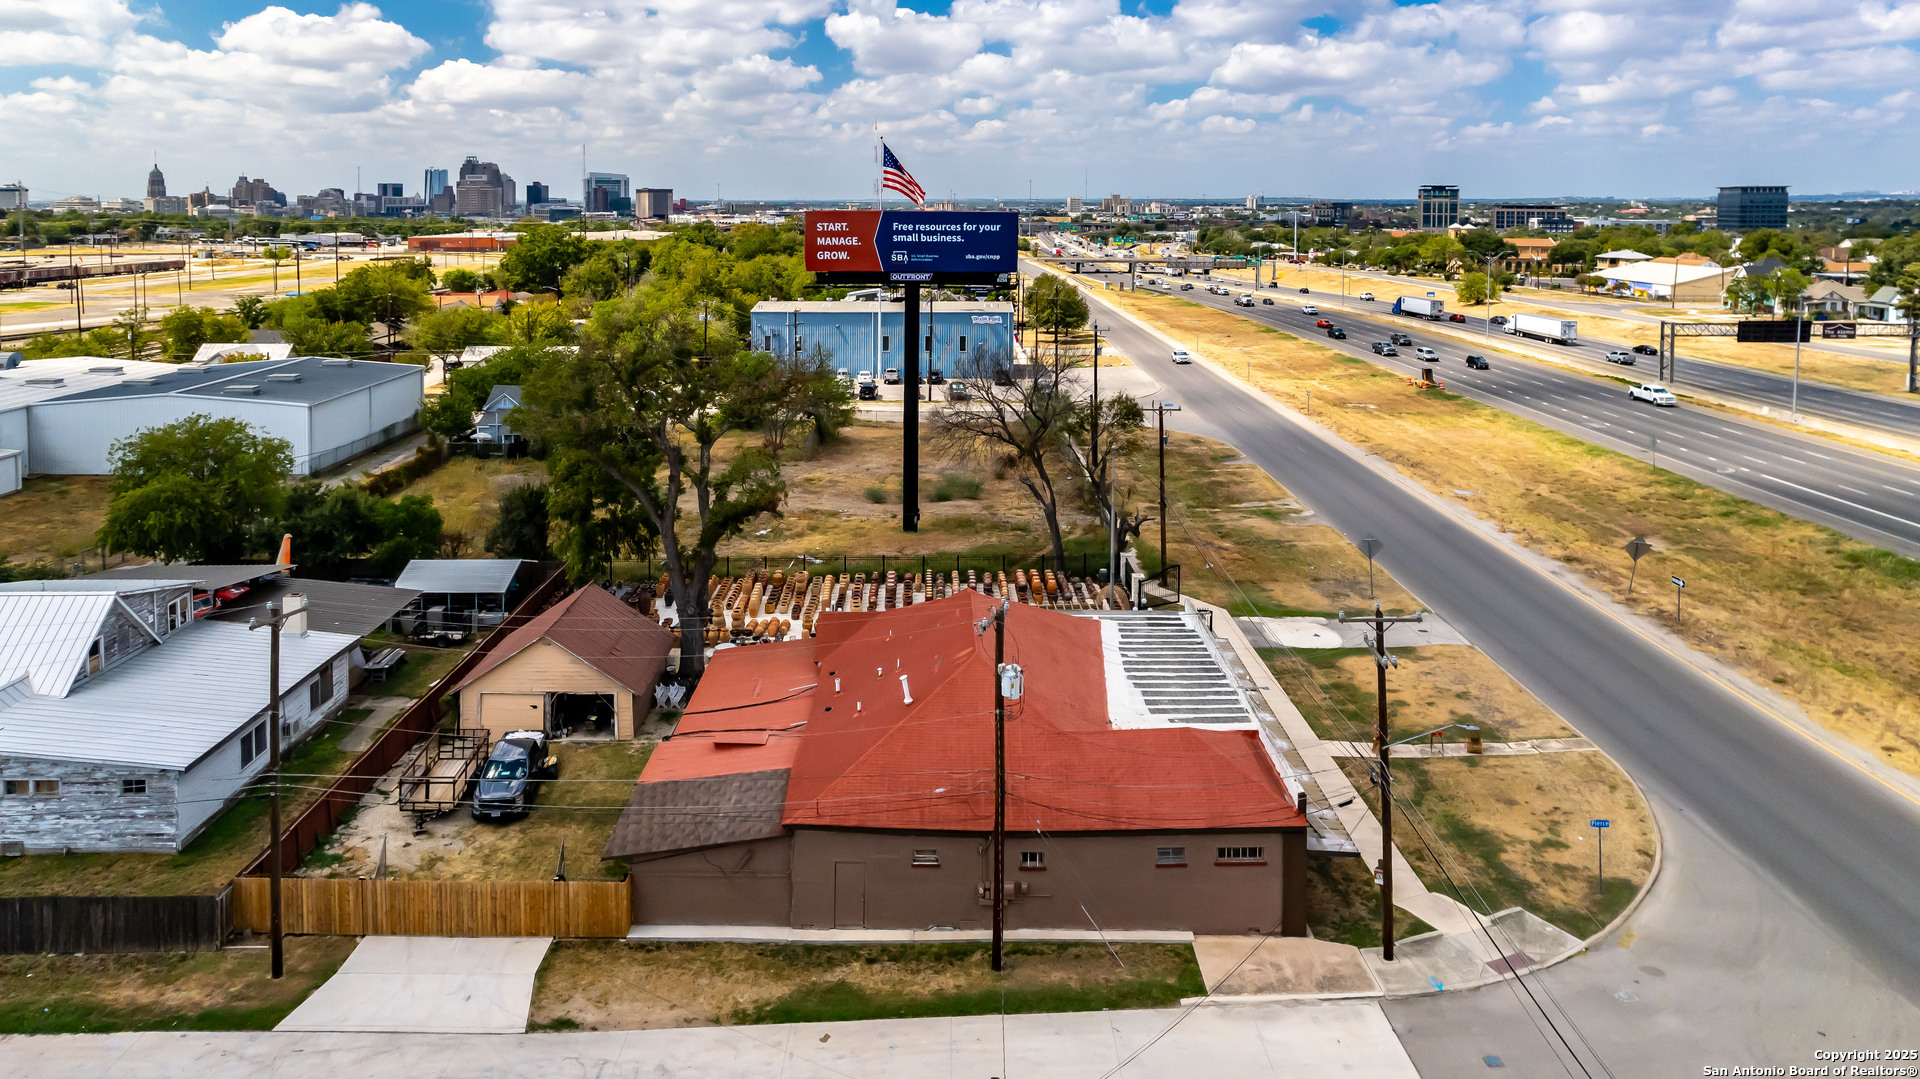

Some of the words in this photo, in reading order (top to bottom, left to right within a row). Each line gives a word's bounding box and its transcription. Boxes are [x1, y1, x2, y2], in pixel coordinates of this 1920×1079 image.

[817, 223, 849, 231] START.
[893, 222, 913, 231] Free
[915, 223, 961, 231] resources
[963, 222, 977, 231] for
[978, 224, 1001, 233] your
[817, 237, 862, 246] MANAGE.
[893, 233, 919, 242] small
[920, 233, 965, 242] business.
[817, 251, 850, 260] GROW.
